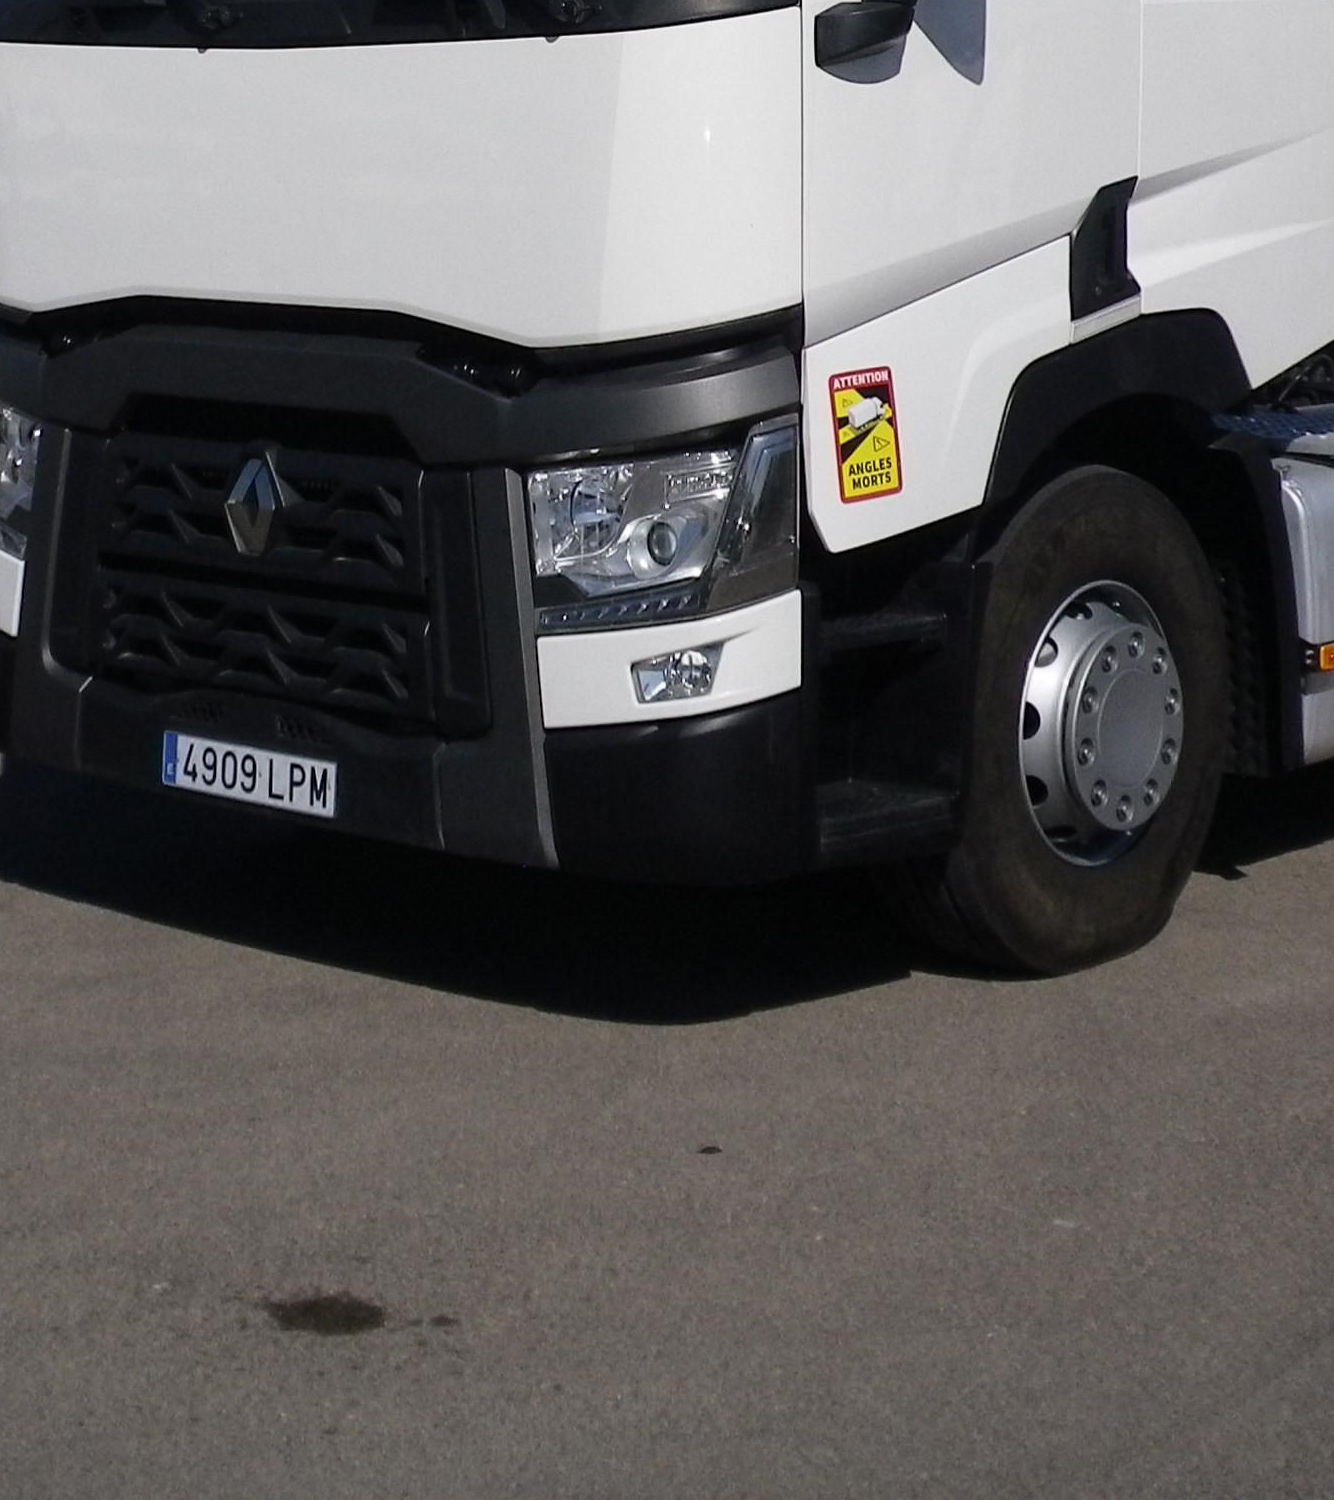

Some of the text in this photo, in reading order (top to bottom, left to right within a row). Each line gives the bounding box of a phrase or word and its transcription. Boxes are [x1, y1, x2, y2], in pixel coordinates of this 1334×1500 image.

[833, 370, 889, 390] ATTENTION
[848, 457, 892, 477] ANGLES
[852, 471, 891, 490] MORTS
[183, 743, 257, 793] 4909
[268, 758, 328, 809] LPM
